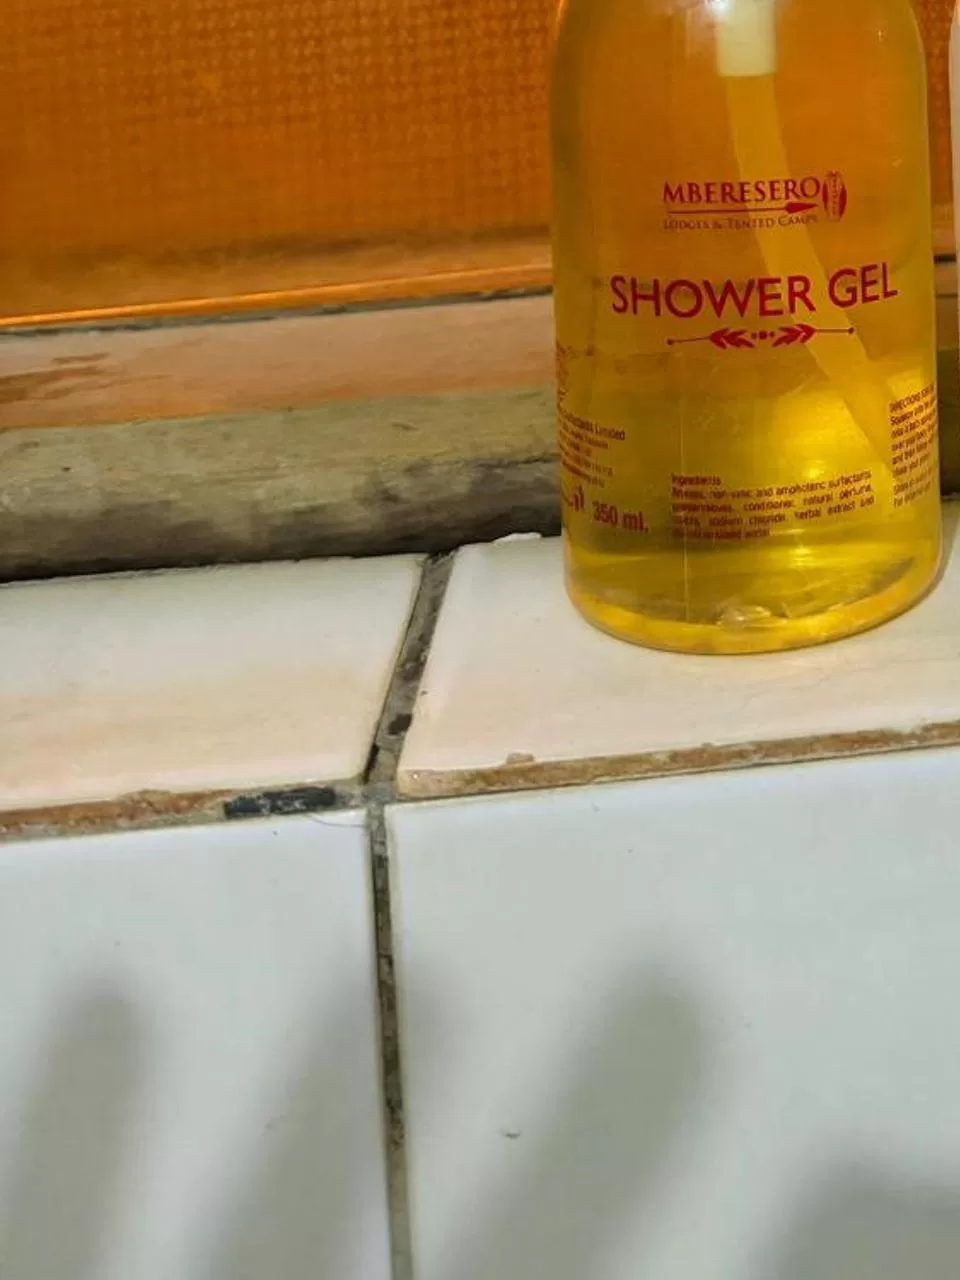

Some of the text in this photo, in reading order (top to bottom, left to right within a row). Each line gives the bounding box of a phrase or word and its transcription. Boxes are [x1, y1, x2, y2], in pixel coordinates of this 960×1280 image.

[663, 176, 821, 204] MBERESERO
[610, 261, 900, 320] SHOWER GEL
[591, 500, 649, 533] 350 ml.
